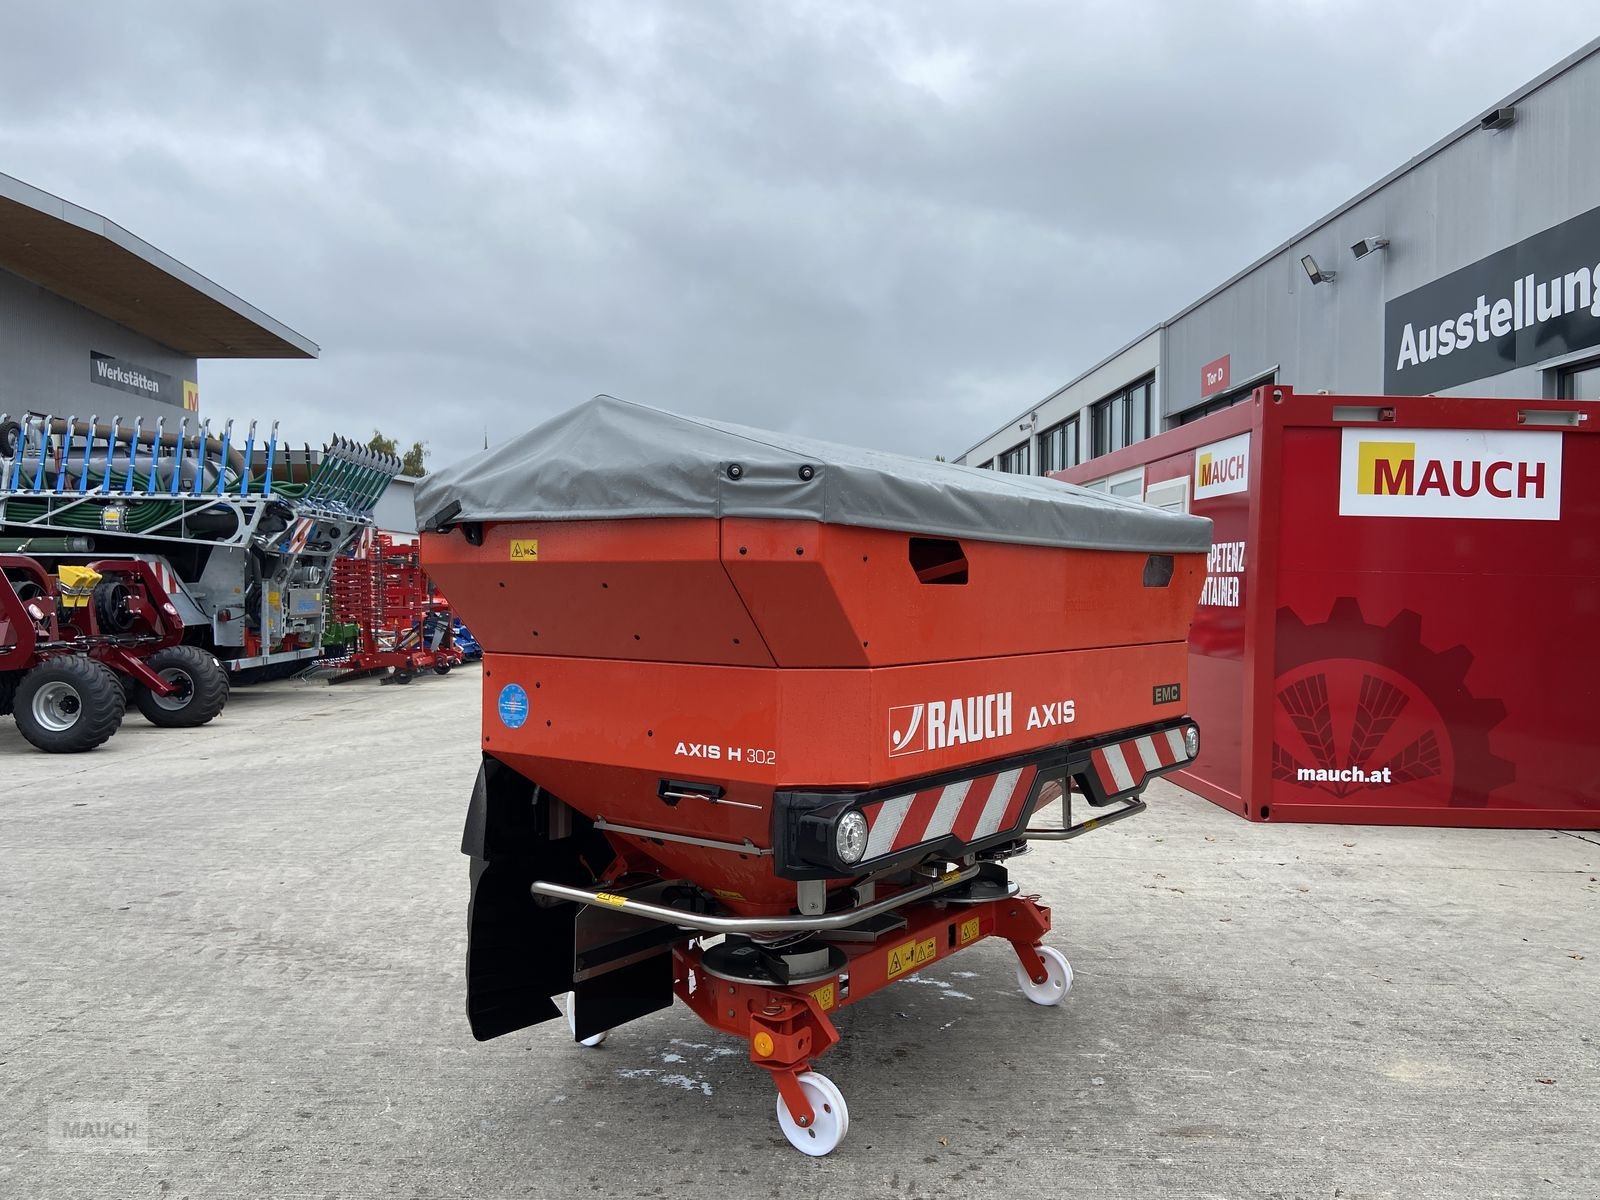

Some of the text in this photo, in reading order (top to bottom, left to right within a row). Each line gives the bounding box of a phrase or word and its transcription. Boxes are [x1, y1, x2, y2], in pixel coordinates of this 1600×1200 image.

[97, 360, 159, 393] Werkstätten
[1207, 367, 1224, 386] Tor D
[1201, 454, 1245, 487] MAUCH
[1373, 458, 1546, 499] MAUCH
[1155, 686, 1178, 703] EMC
[927, 691, 1076, 751] RAUCH AXIS
[674, 742, 776, 765] AXIS H 30.2
[1297, 765, 1392, 783] mauch.at
